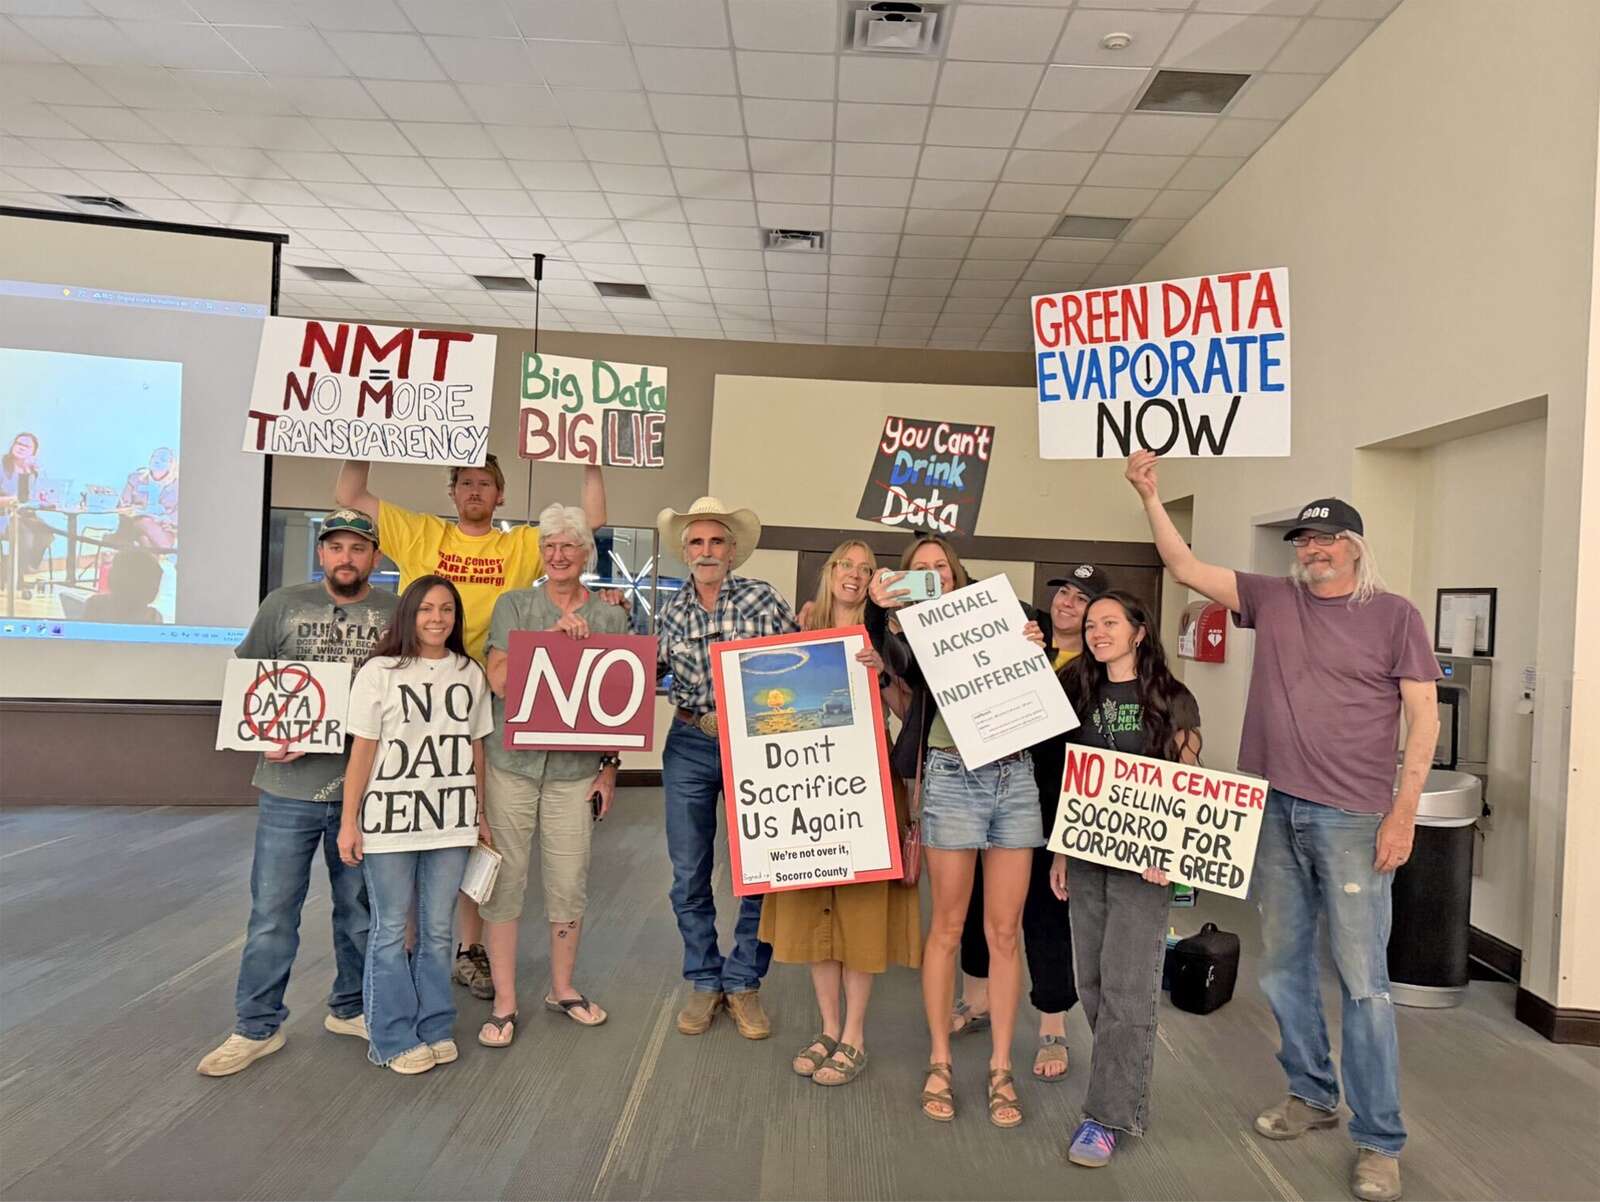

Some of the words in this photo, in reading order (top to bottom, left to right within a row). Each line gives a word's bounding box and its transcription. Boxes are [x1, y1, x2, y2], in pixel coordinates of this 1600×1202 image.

[1035, 286, 1149, 348] GREEN
[1161, 271, 1283, 337] DATA
[300, 321, 474, 381] NMT
[1038, 332, 1285, 402] EVAPORATE
[283, 371, 341, 415] NO
[357, 380, 474, 422] MORE
[522, 352, 584, 413] Big
[592, 359, 667, 411] Data
[248, 410, 489, 464] TRANSPARENCY
[518, 407, 598, 464] BIG
[608, 411, 666, 467] LIE
[933, 423, 990, 460] Can't
[1096, 395, 1241, 458] NOW
[889, 450, 966, 491] Drink
[880, 485, 959, 533] Data
[917, 589, 998, 628] MICHAEL
[932, 617, 1010, 657] JACKSON
[972, 650, 991, 668] IS
[255, 661, 311, 694] NO
[506, 646, 646, 730] NO
[936, 654, 1047, 707] INDIFFERENT
[243, 692, 311, 718] DATA
[397, 682, 473, 723] NO
[237, 719, 341, 747] CENTER
[765, 734, 835, 769] Don't
[375, 734, 475, 781] DAT
[1063, 750, 1105, 798] NO
[1114, 758, 1163, 787] DATA
[1172, 771, 1265, 810] CENTER
[361, 785, 480, 834] CENT
[739, 775, 867, 806] Sacrifice
[1108, 784, 1186, 820] SELLING
[1197, 804, 1247, 832] OUT
[791, 807, 864, 842] Again
[1064, 798, 1168, 842] SOCORRO
[1181, 827, 1232, 861] FOR
[770, 851, 798, 861] We're
[800, 849, 815, 859] not
[816, 847, 837, 856] over
[838, 844, 849, 855] it,
[775, 871, 813, 882] Socorro
[814, 866, 848, 878] County
[1062, 826, 1175, 872] CORPORATE
[1179, 854, 1245, 889] GREED
